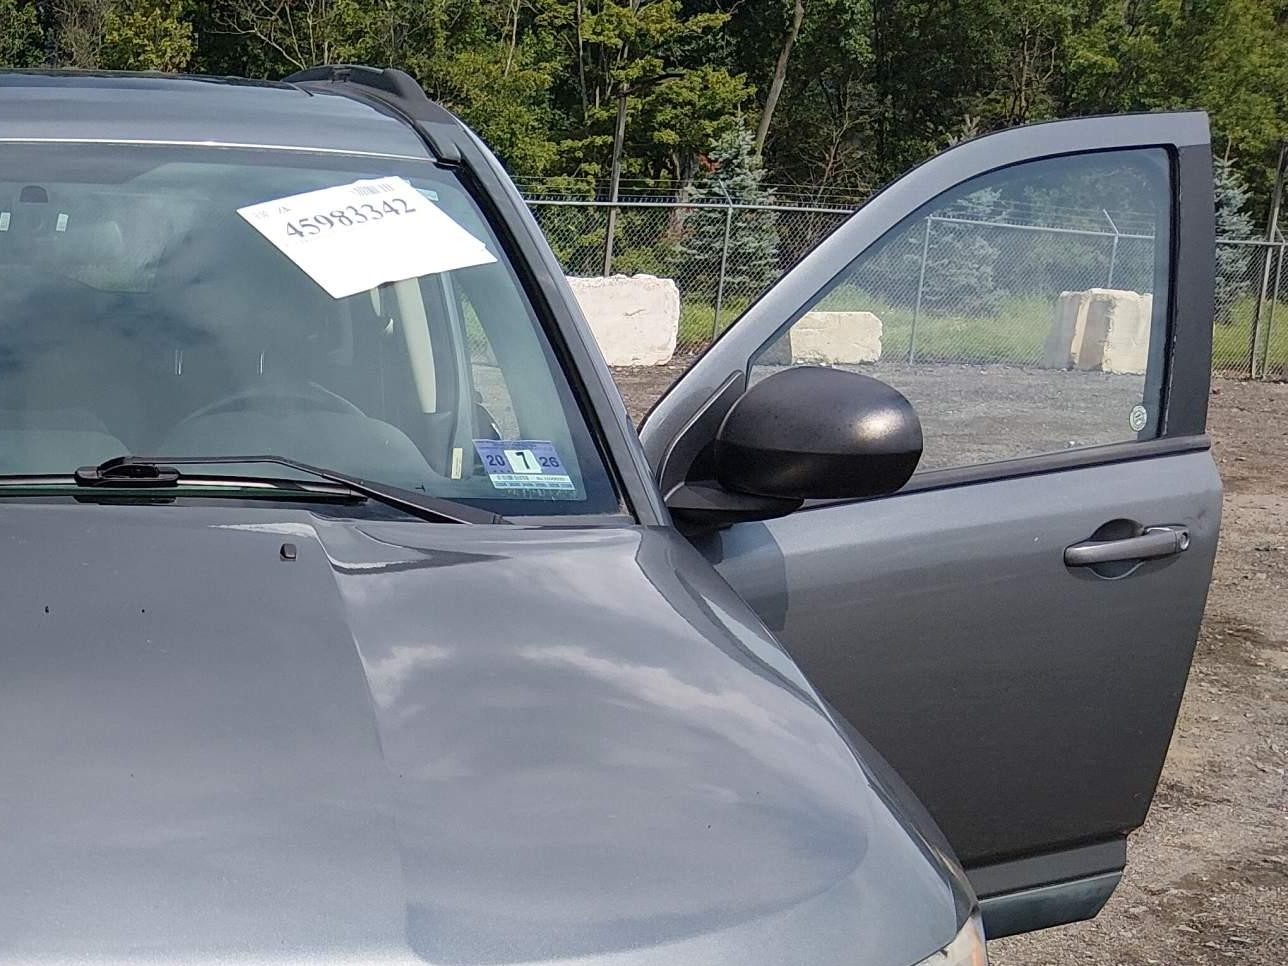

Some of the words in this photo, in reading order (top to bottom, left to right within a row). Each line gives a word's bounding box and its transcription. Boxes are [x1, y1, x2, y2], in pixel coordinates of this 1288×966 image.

[286, 198, 417, 239] 45983342
[486, 454, 506, 467] 20
[515, 451, 531, 470] 7
[538, 456, 560, 468] 26
